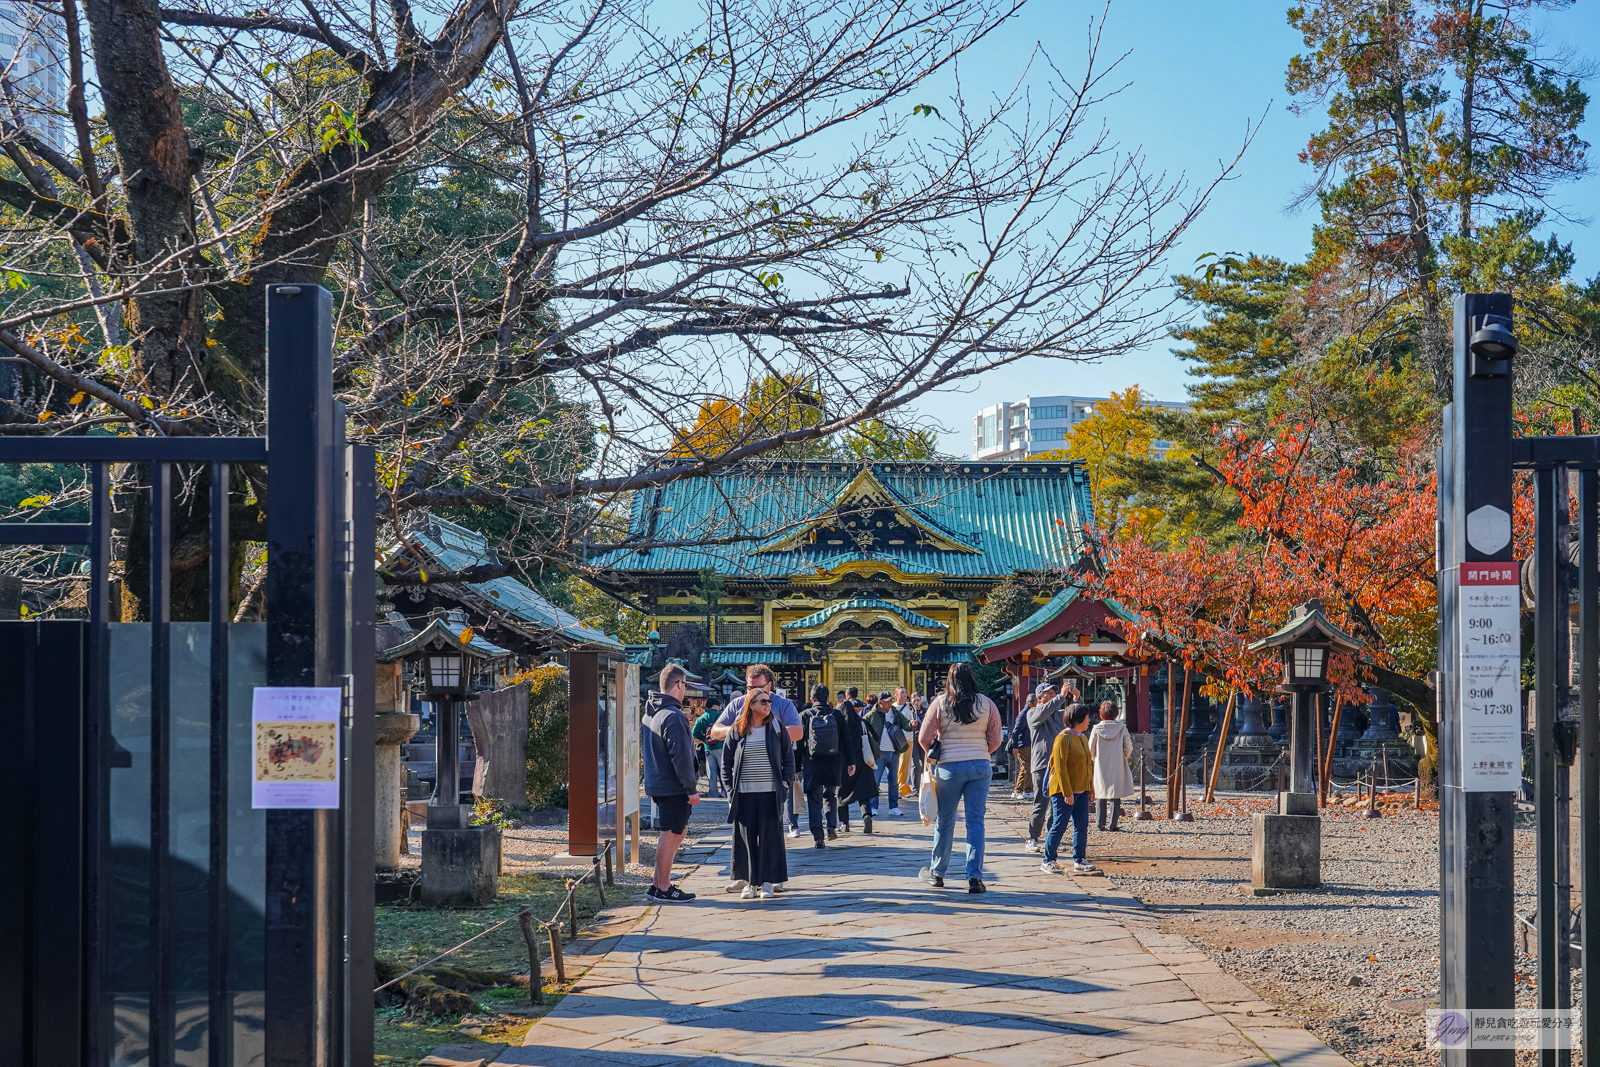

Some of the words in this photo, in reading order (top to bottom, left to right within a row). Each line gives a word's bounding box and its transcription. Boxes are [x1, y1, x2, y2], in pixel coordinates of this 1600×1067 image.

[1468, 570, 1512, 581] 開門時間
[1469, 618, 1493, 629] 9:00
[1470, 688, 1493, 699] 9:00
[1471, 760, 1514, 770] 上野東照宮
